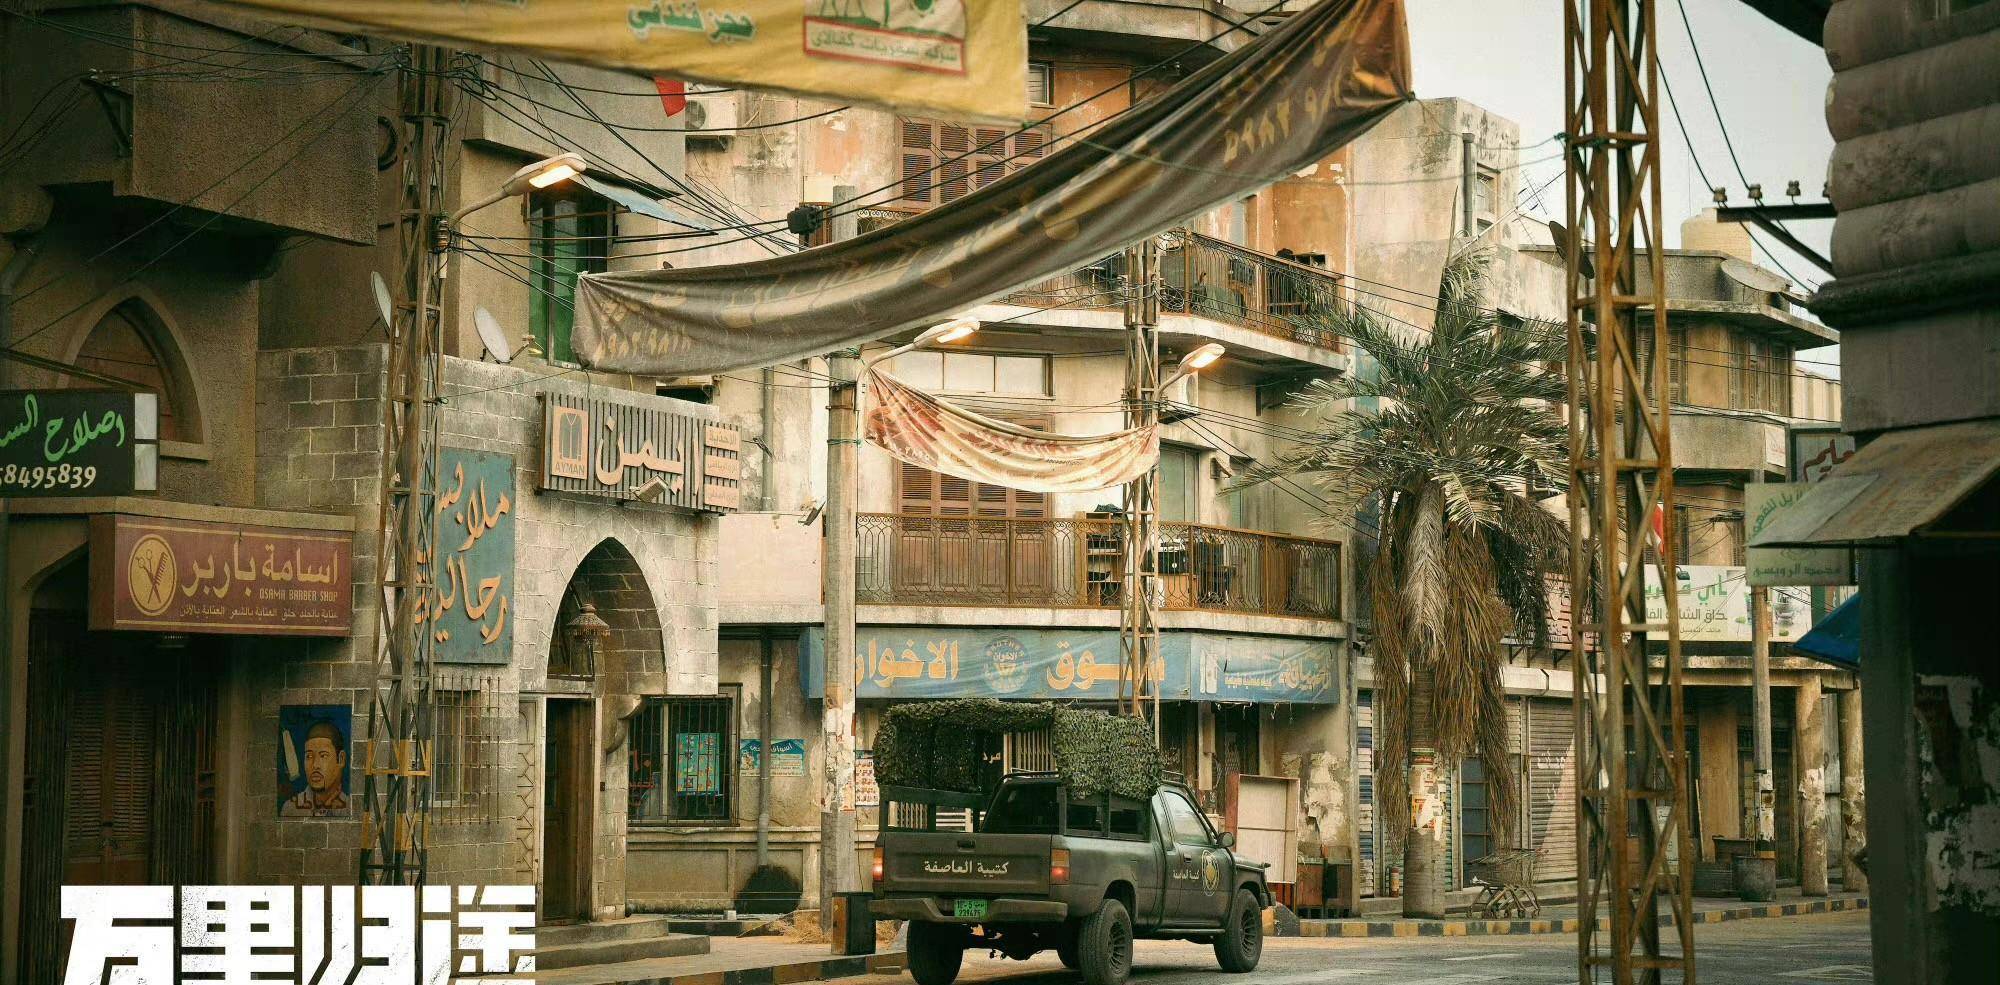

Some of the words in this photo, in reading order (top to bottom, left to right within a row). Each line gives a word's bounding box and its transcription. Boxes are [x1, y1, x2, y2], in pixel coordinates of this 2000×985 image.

[627, 3, 705, 38] فندقي
[709, 13, 755, 41] حجز
[44, 410, 125, 462] اصلاح
[554, 461, 585, 476] AYMAN
[595, 416, 700, 496] ايمن
[181, 540, 257, 598] باربر
[261, 543, 339, 585] اسامة
[259, 588, 286, 600] OSAMA
[288, 589, 318, 601] BARBER
[320, 591, 338, 602] SHOP
[856, 639, 959, 689] الاخوا
[924, 859, 973, 874] العاصفة
[977, 861, 1010, 878] كتيبة
